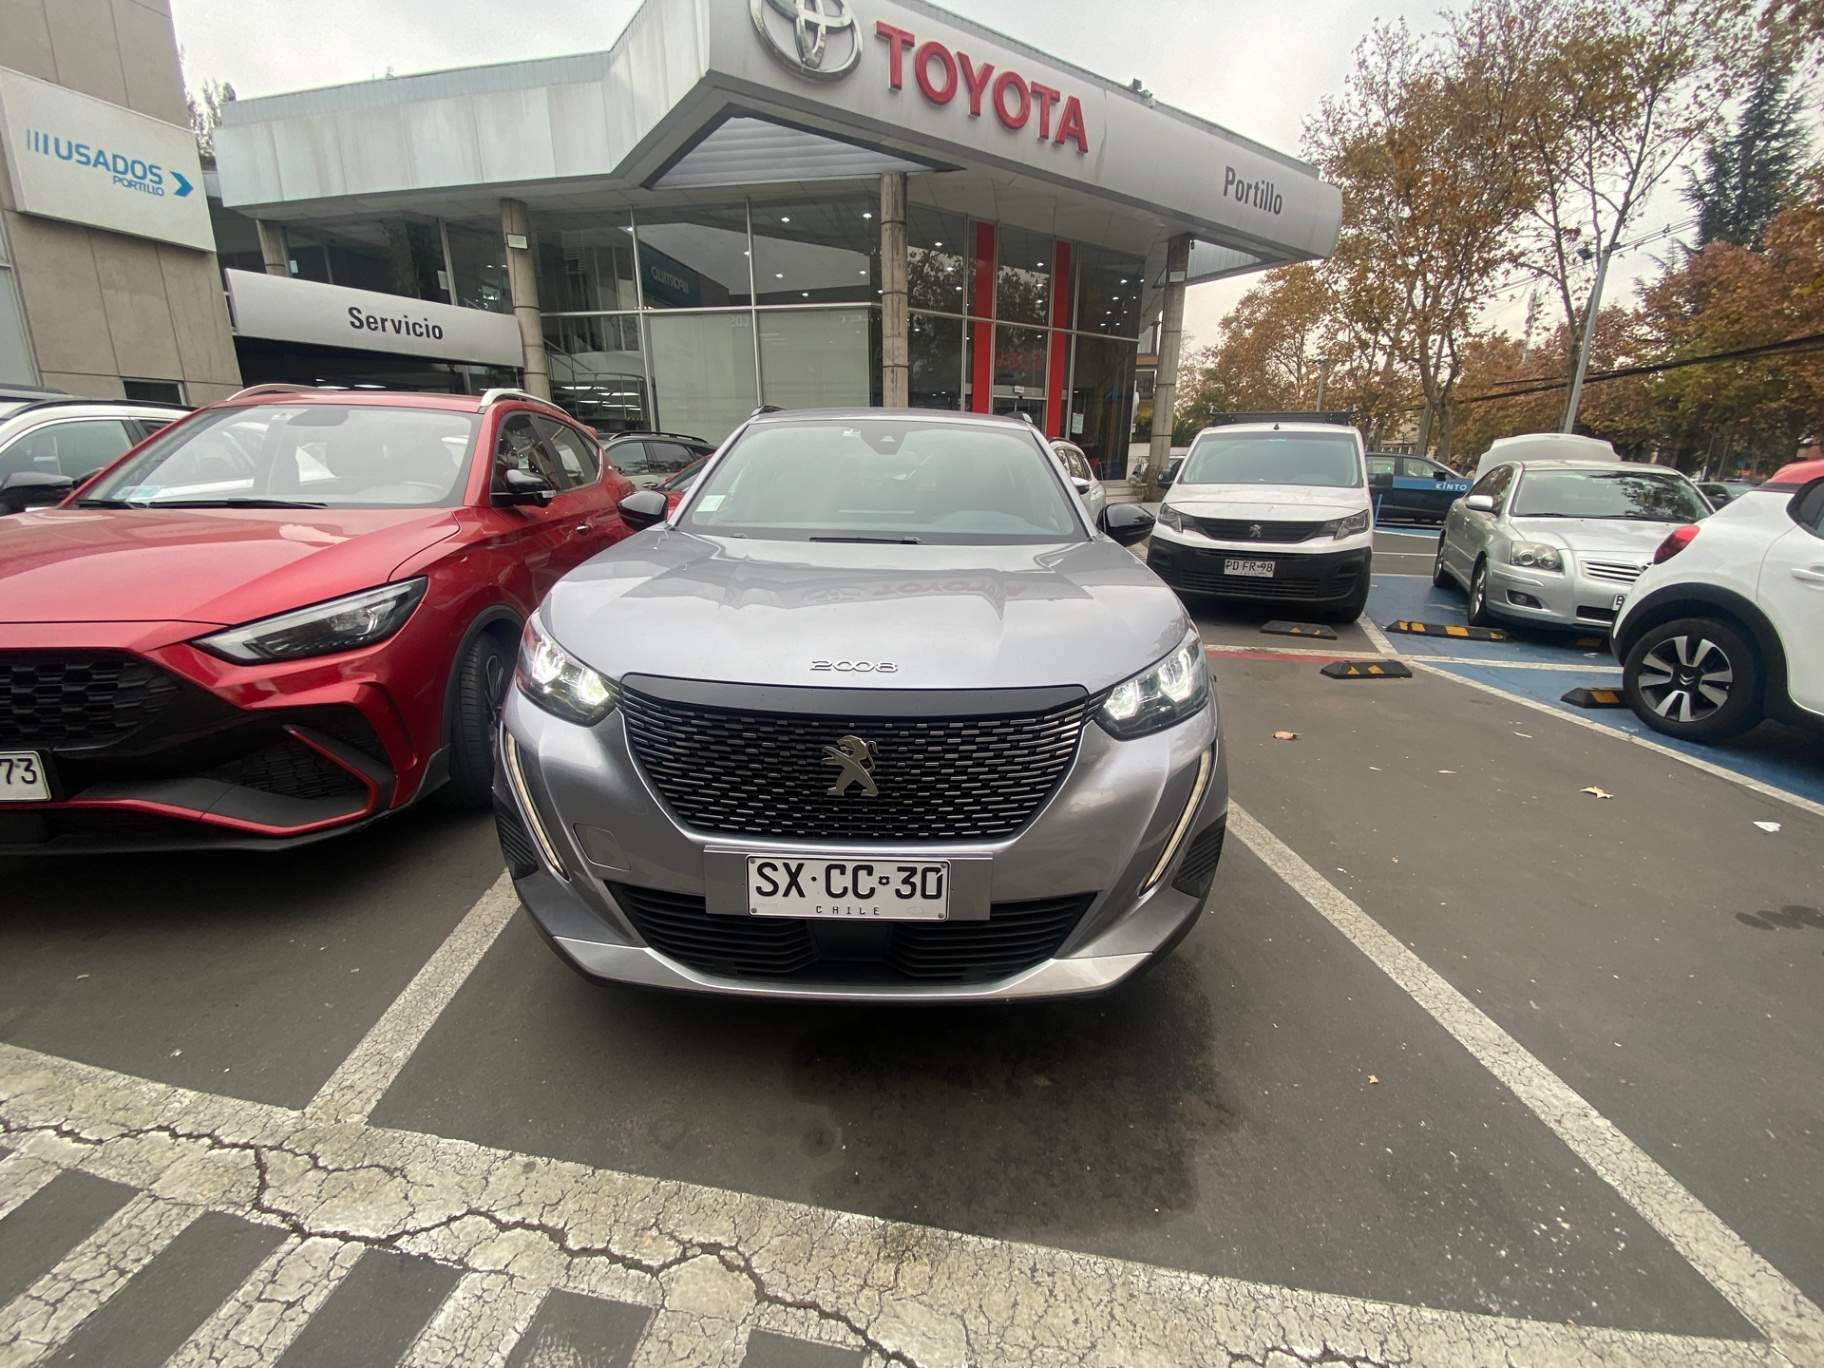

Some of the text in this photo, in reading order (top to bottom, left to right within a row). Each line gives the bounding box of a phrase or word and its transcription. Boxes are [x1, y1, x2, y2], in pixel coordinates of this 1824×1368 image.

[874, 20, 1089, 153] TOYOTA
[54, 137, 164, 185] USADOS
[112, 175, 165, 197] PORTILLO
[1223, 165, 1283, 215] Portillo
[347, 306, 444, 340] Servicio
[809, 659, 898, 673] 2008
[815, 905, 881, 916] CHILE
